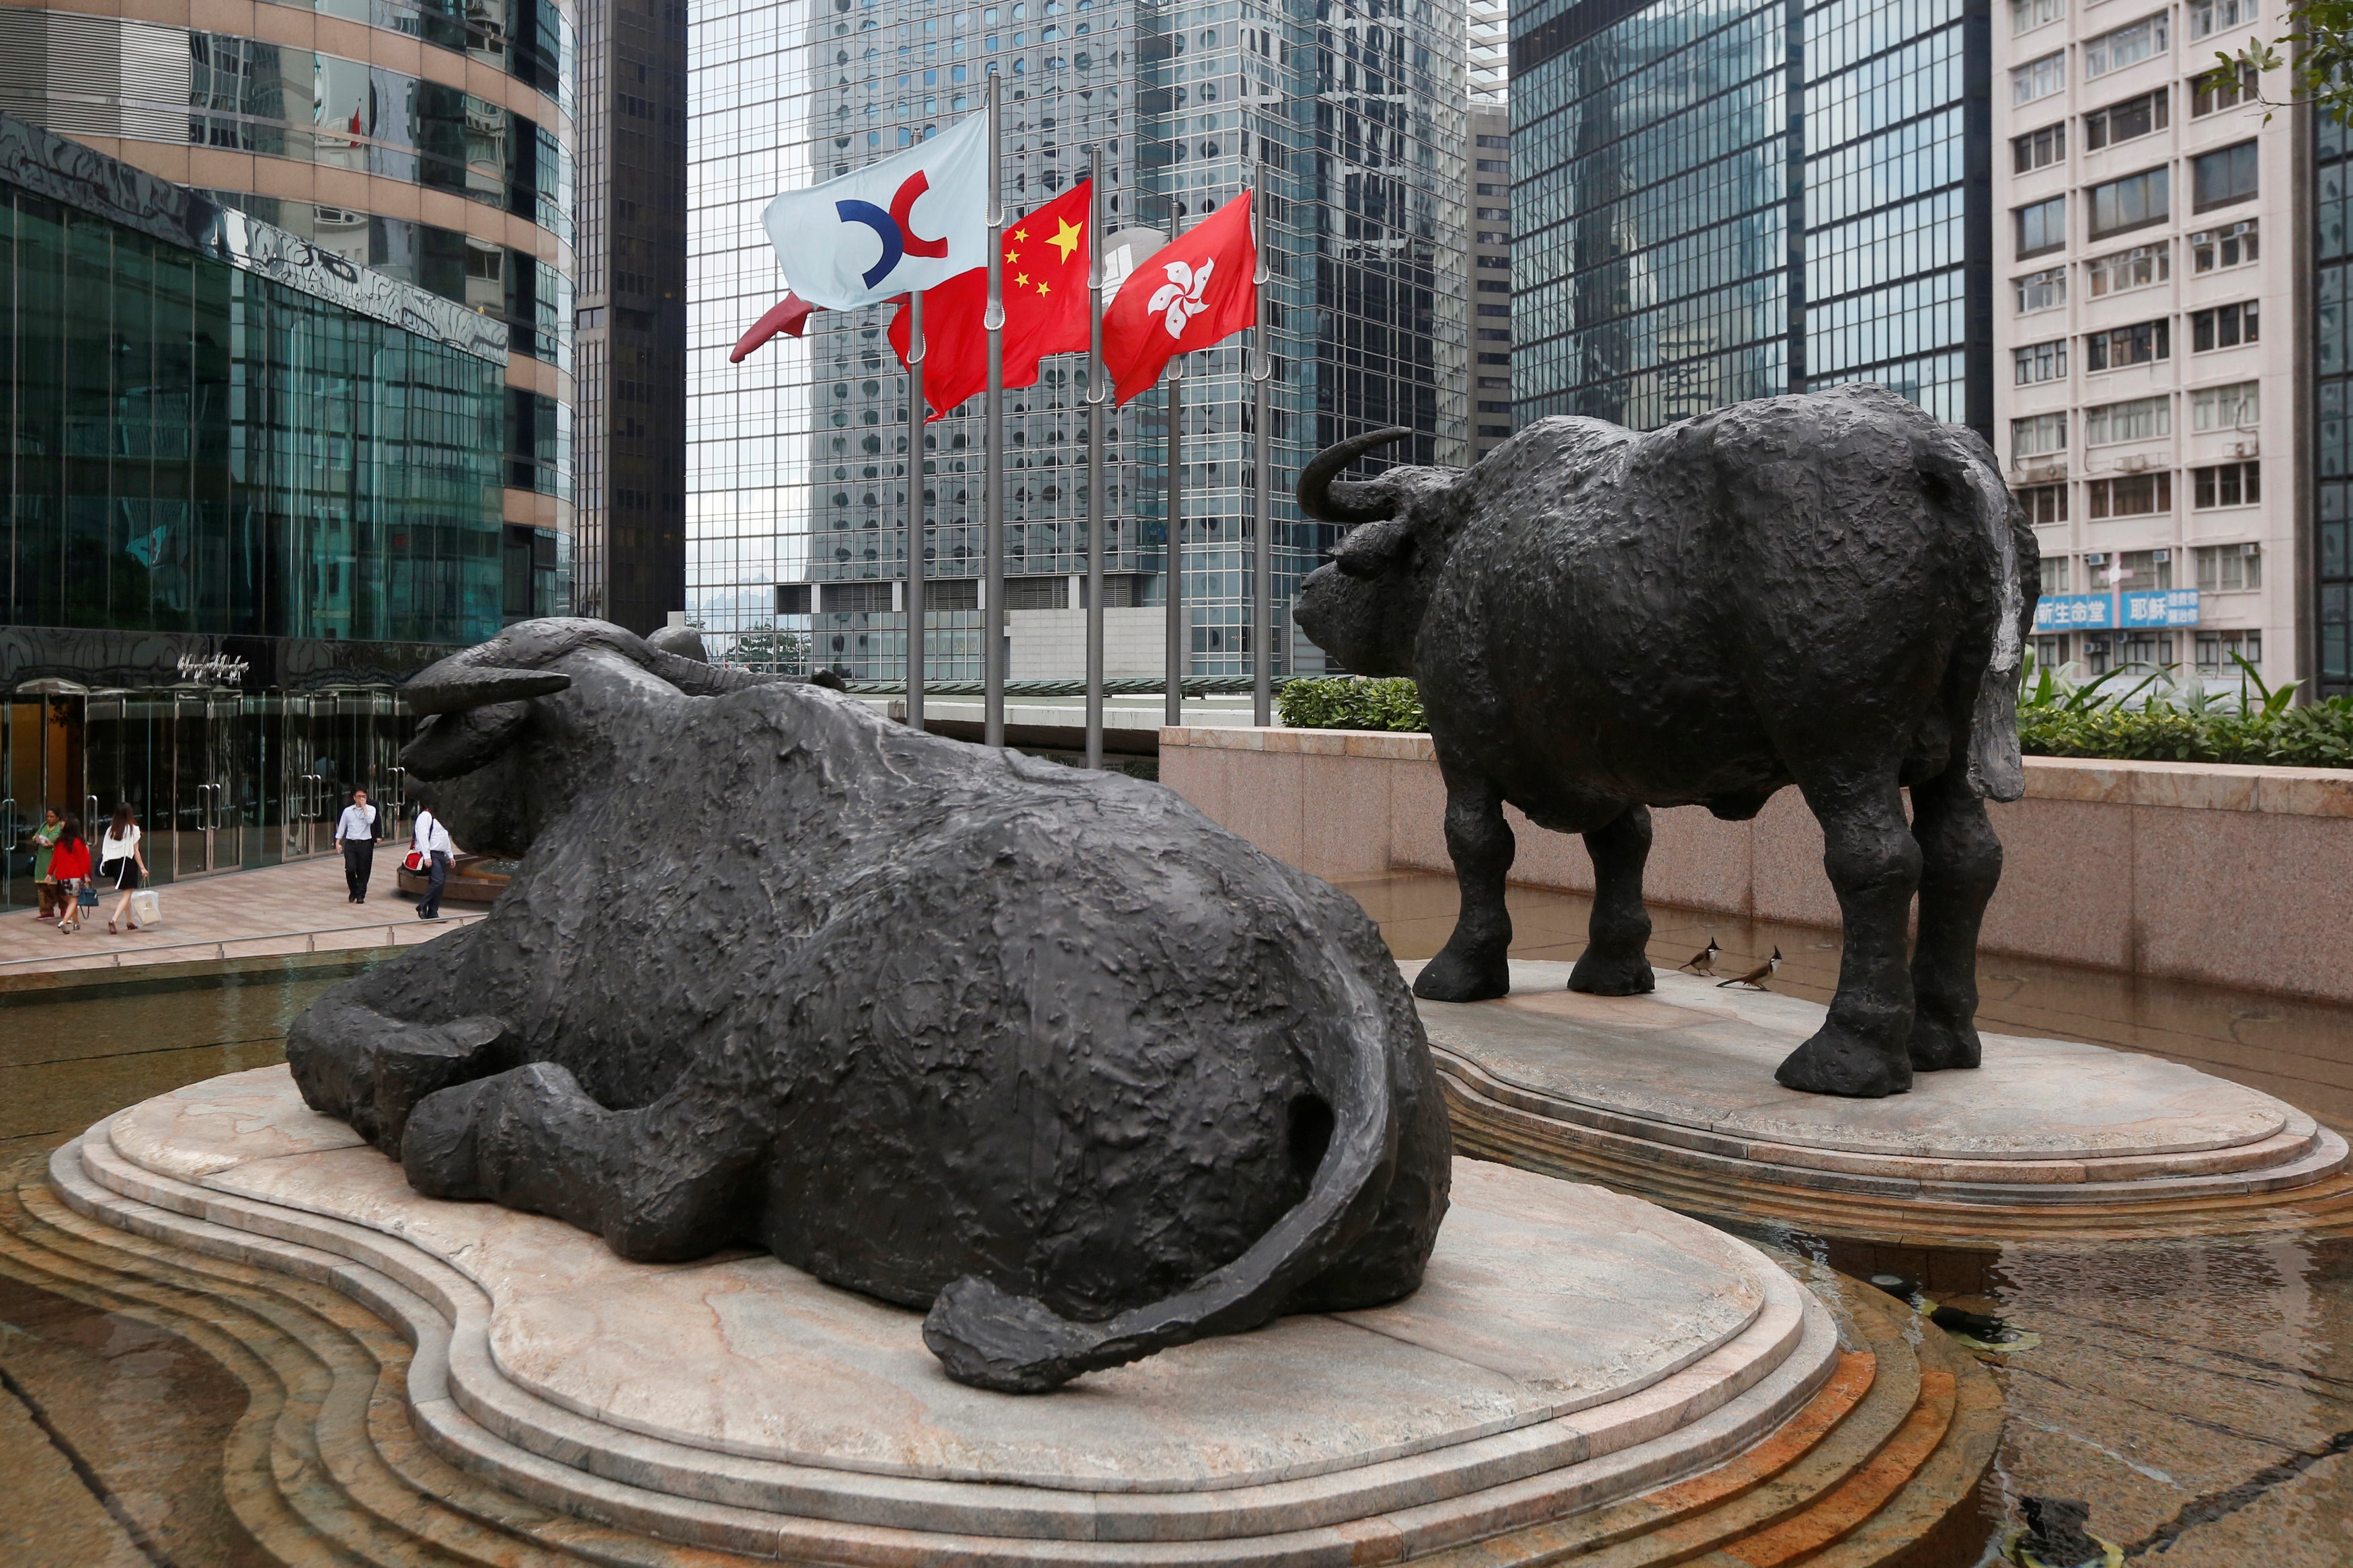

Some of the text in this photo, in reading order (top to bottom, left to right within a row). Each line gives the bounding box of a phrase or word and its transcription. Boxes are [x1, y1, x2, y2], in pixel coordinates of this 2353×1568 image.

[2038, 600, 2105, 624] 新生命堂
[2130, 597, 2165, 620] 耶穌
